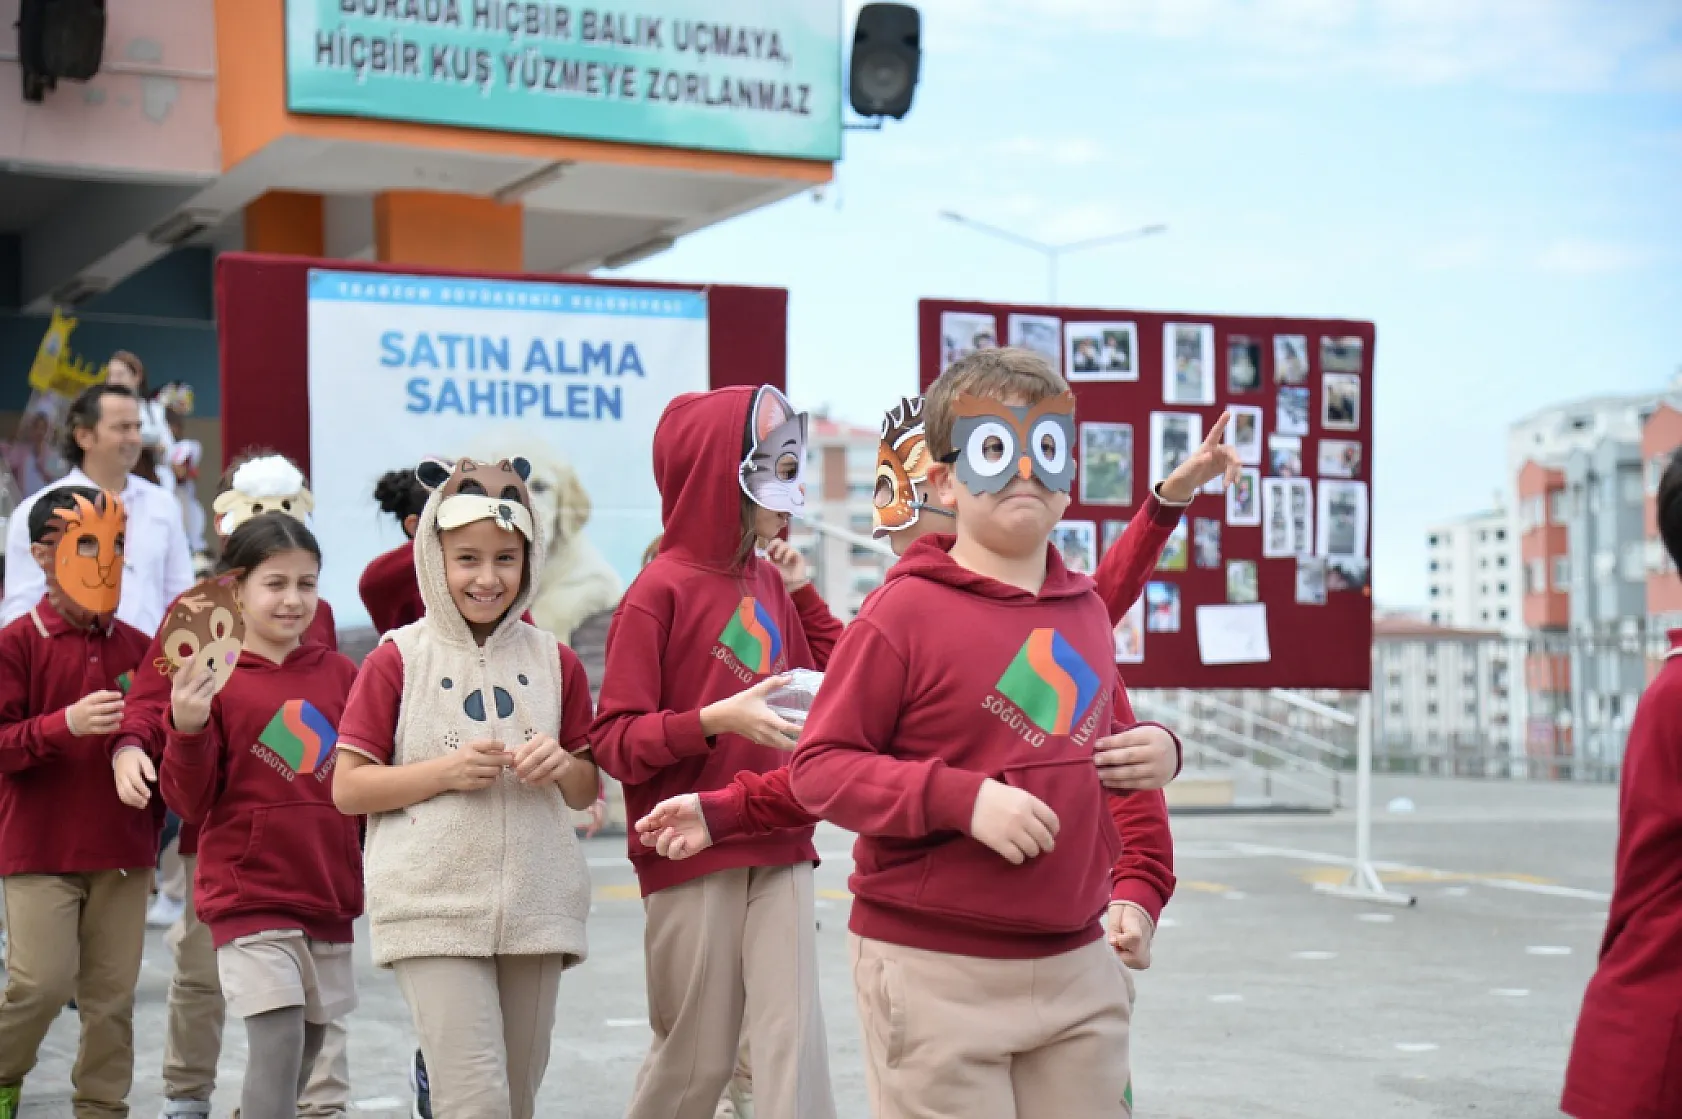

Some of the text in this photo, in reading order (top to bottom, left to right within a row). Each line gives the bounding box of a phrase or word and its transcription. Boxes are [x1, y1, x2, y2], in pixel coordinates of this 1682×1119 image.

[581, 8, 663, 48] BALIK
[672, 17, 791, 66] UÇMAYA,
[315, 24, 811, 115] HİÇBİR KUŞ YÜZMEYE ZORLANMAZ
[380, 330, 646, 377] SATIN ALMA
[981, 694, 1046, 747] SÖĞÜTLÜ
